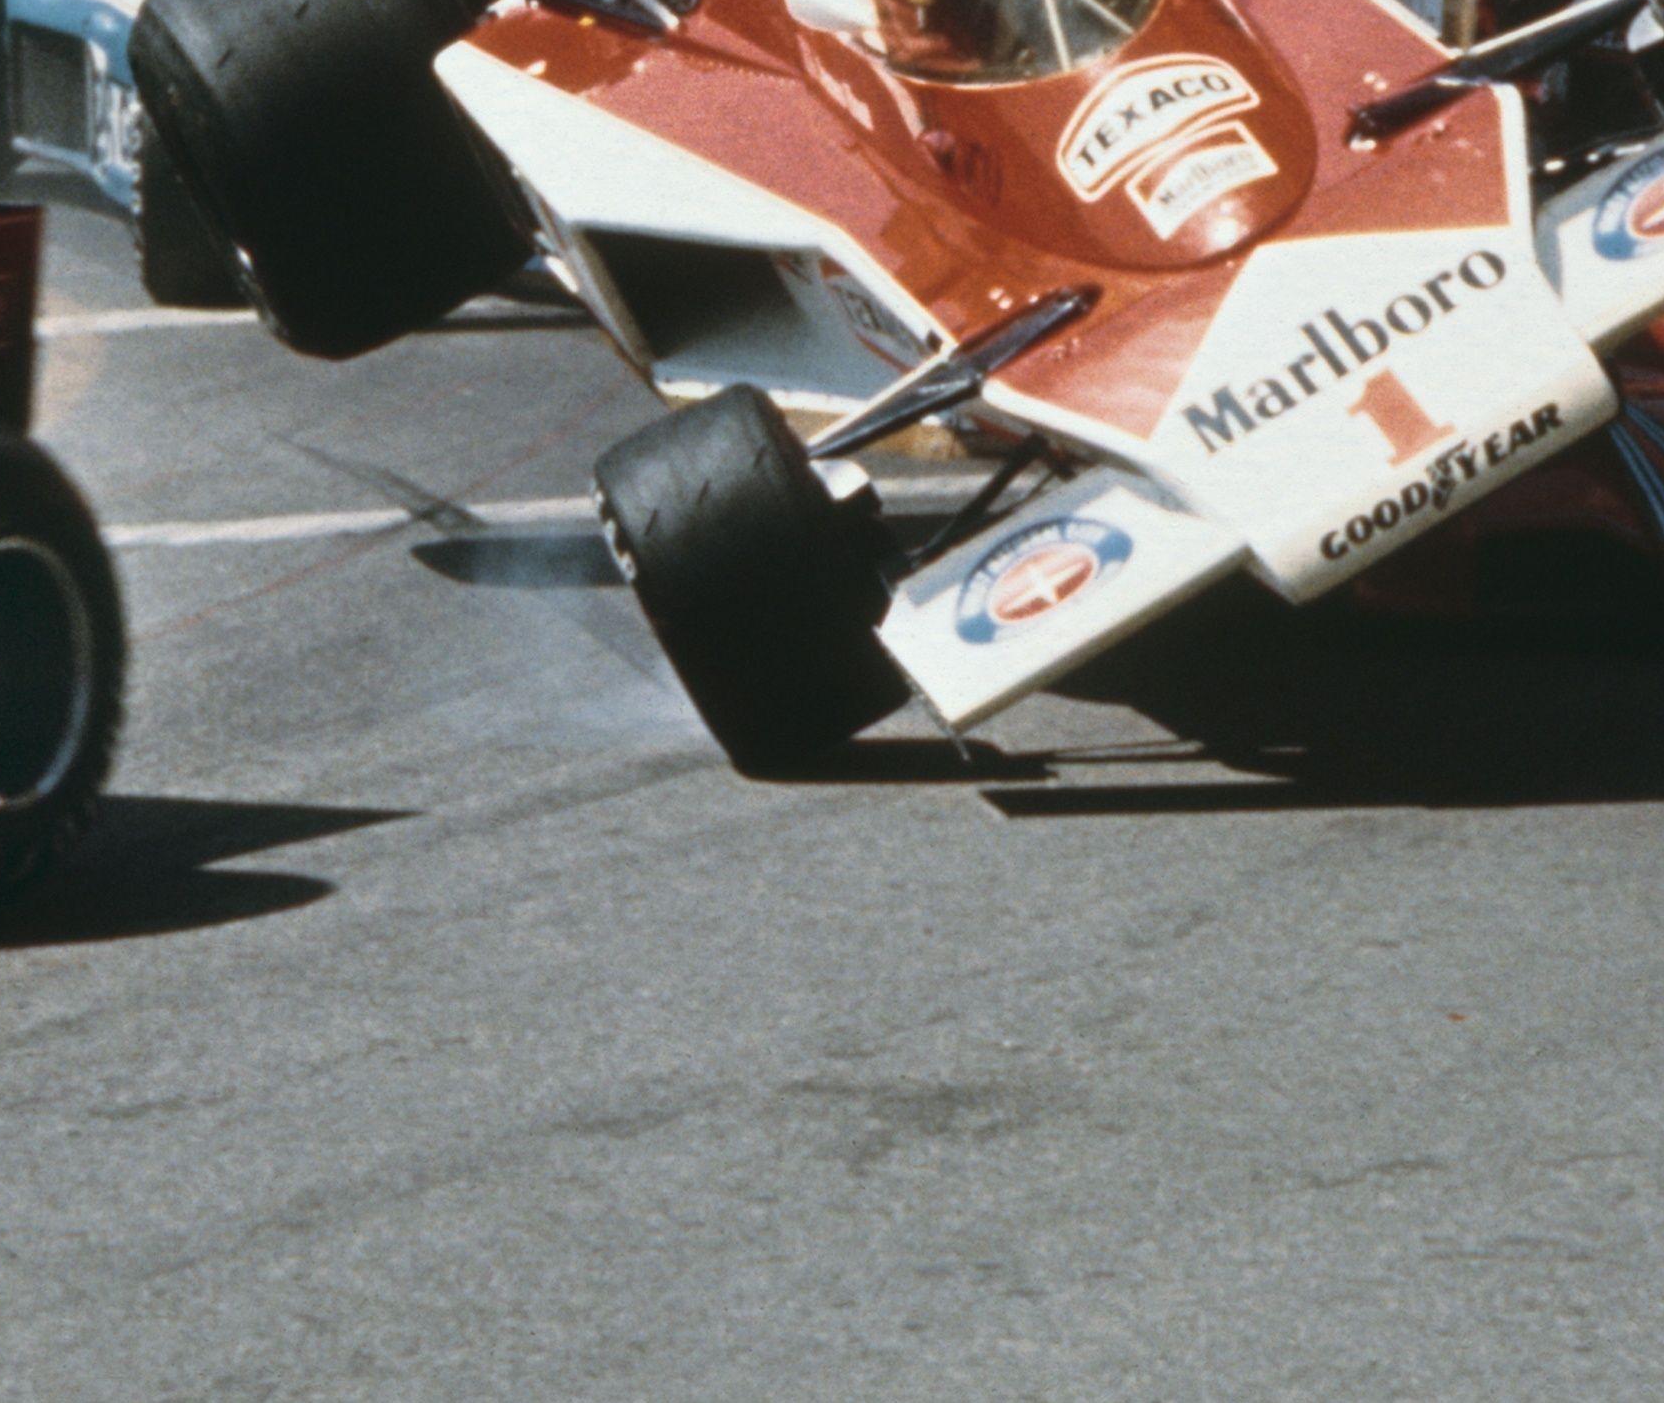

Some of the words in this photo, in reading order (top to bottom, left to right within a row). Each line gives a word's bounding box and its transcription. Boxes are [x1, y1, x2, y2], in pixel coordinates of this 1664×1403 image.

[1077, 72, 1232, 167] TEXACO
[1181, 245, 1507, 460] Marlboro
[1346, 367, 1456, 469] 1
